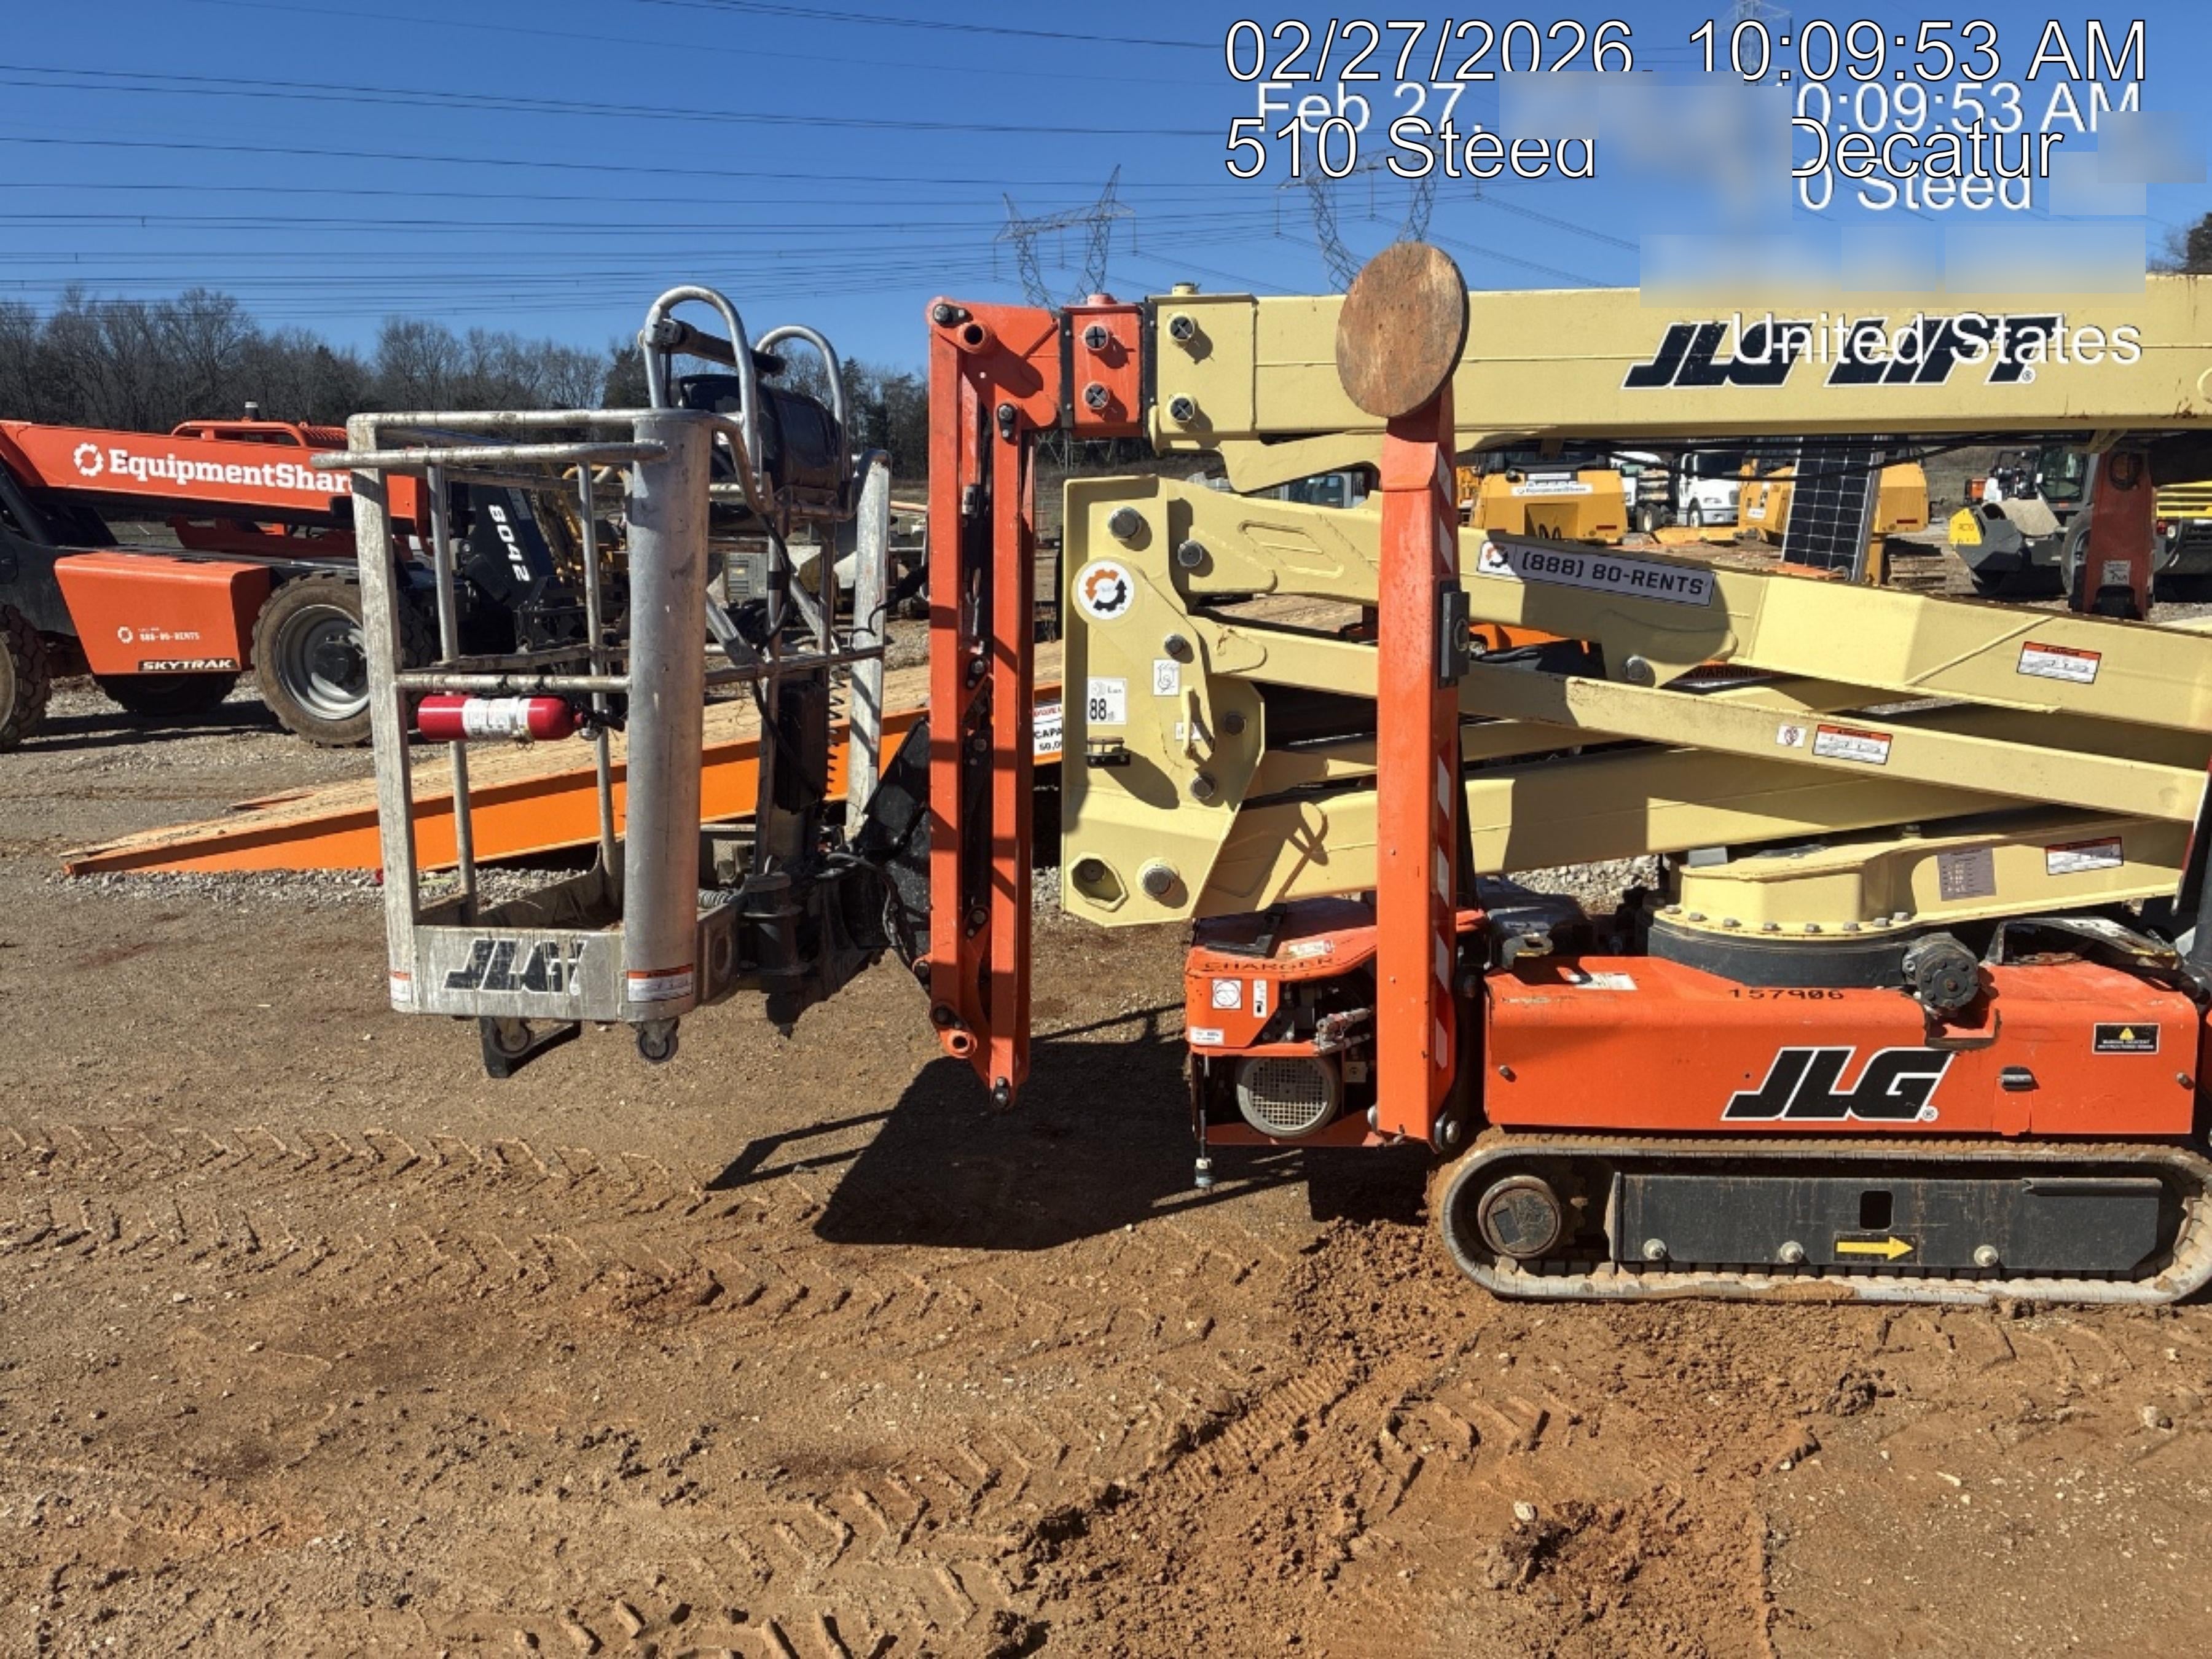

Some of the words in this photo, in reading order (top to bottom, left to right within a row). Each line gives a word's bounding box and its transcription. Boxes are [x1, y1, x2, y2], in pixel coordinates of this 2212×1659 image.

[1620, 319, 1818, 390] JLG
[108, 448, 353, 492] EquipmentShar
[488, 504, 531, 582] 8042
[1521, 553, 1585, 578] (888)
[1591, 563, 1704, 595] 80-RENTS
[143, 659, 232, 670] SKYTRAK
[1089, 697, 1107, 720] 88
[444, 938, 589, 994] JLG
[1720, 1046, 1956, 1123] JLG
